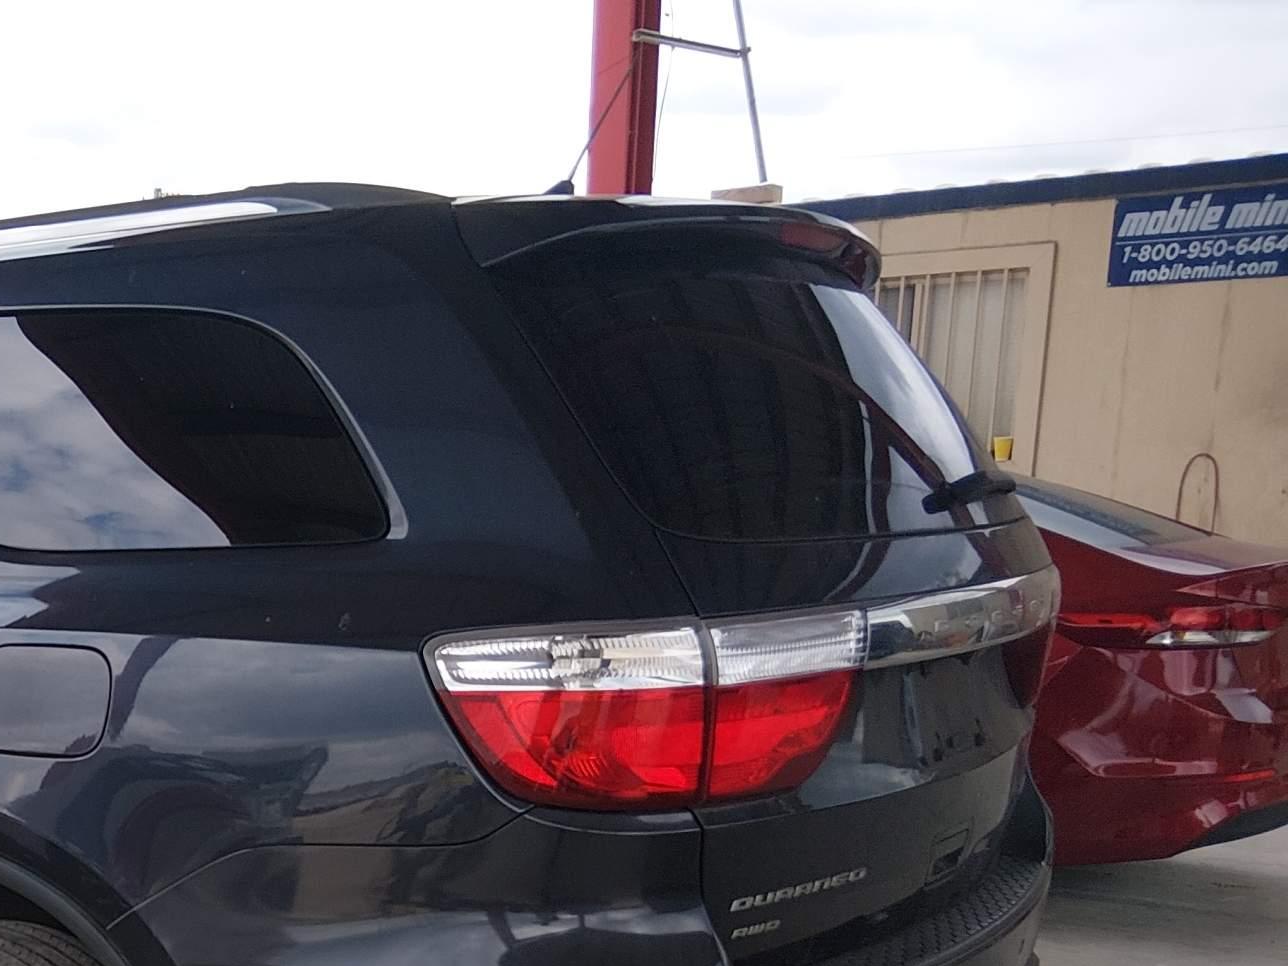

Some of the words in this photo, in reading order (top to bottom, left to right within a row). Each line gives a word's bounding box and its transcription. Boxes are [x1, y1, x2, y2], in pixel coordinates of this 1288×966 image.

[1117, 193, 1225, 238] mobile
[1225, 192, 1288, 230] min
[1122, 234, 1288, 264] 1-800-950-6464
[1128, 260, 1279, 283] mobilemini.com
[729, 866, 868, 913] DURANGO
[730, 919, 781, 940] AWD
